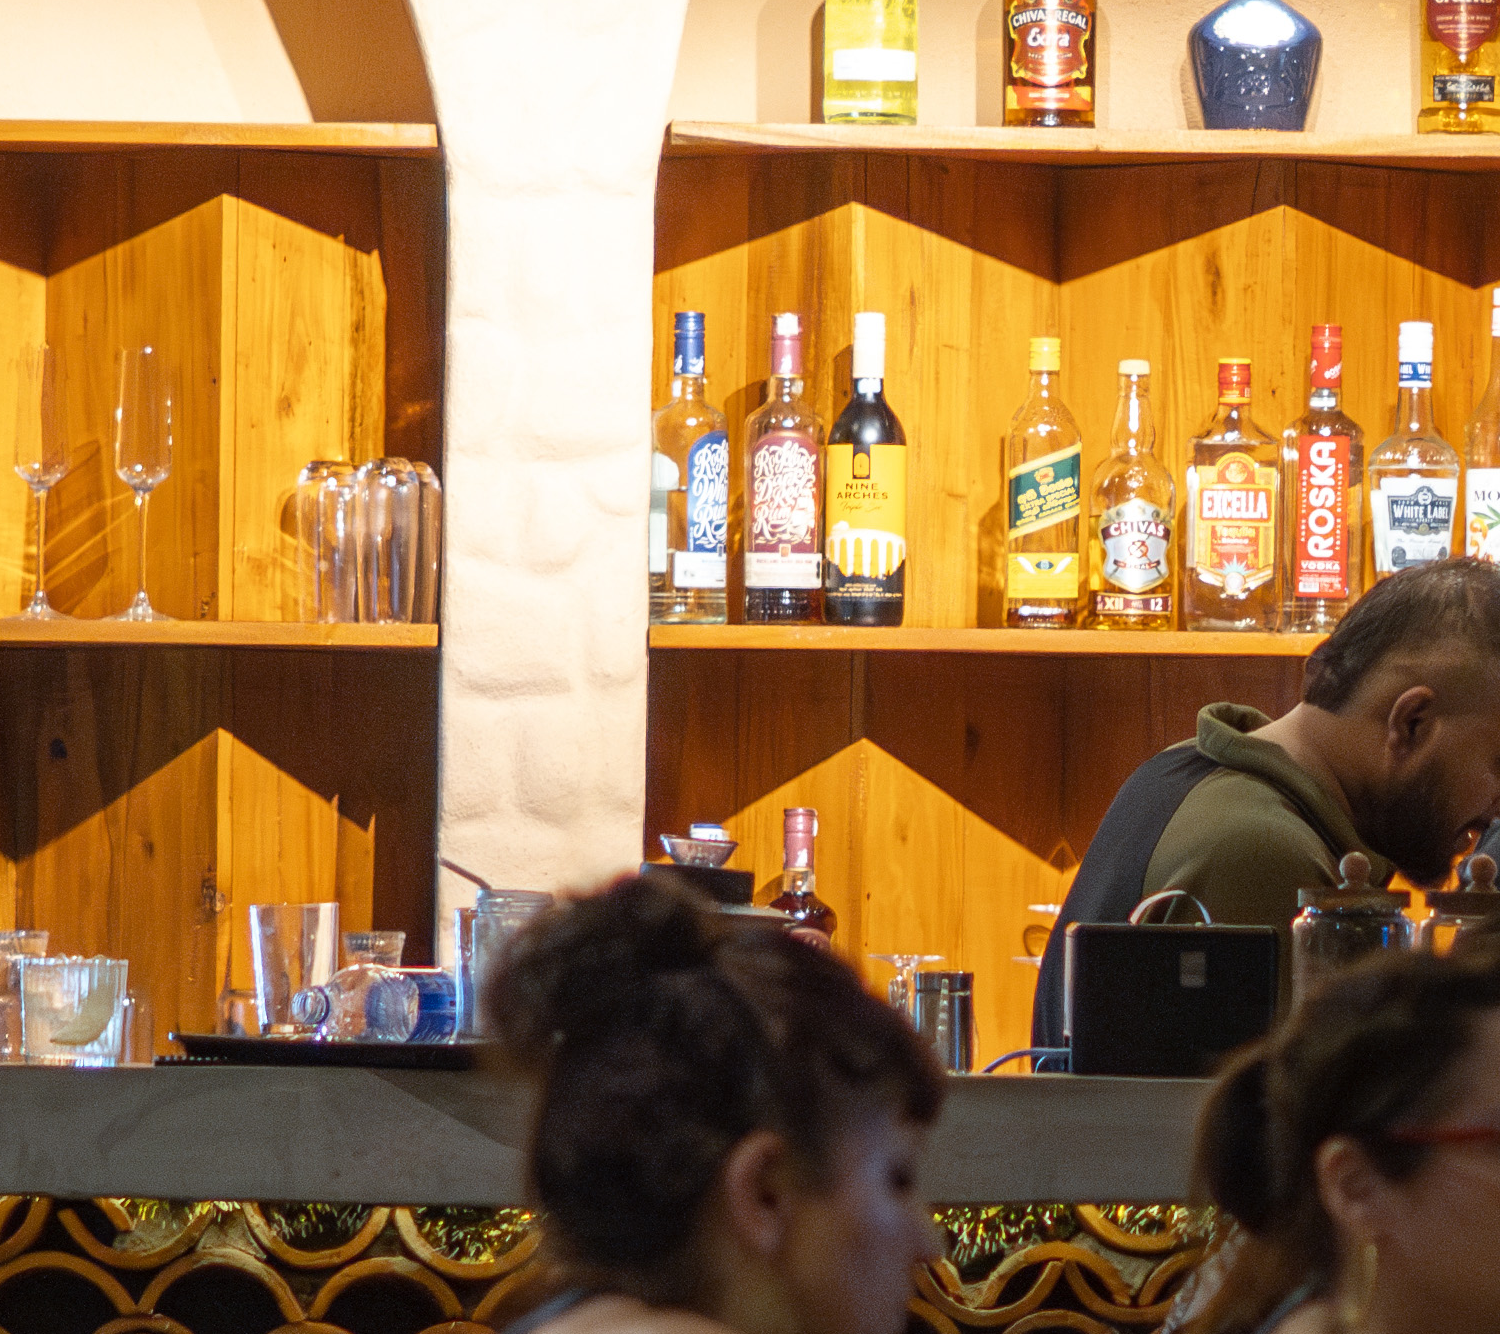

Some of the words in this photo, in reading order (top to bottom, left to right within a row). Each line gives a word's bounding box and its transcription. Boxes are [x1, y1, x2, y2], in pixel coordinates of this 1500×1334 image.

[845, 482, 879, 491] NINE
[836, 491, 889, 500] ARCHES
[1308, 441, 1337, 558] ROSKA
[1202, 490, 1268, 519] EXCELLA
[1392, 503, 1425, 518] WHITE
[1426, 503, 1449, 519] LABEL
[1109, 520, 1165, 537] CHIVAS
[1150, 598, 1164, 611] 12
